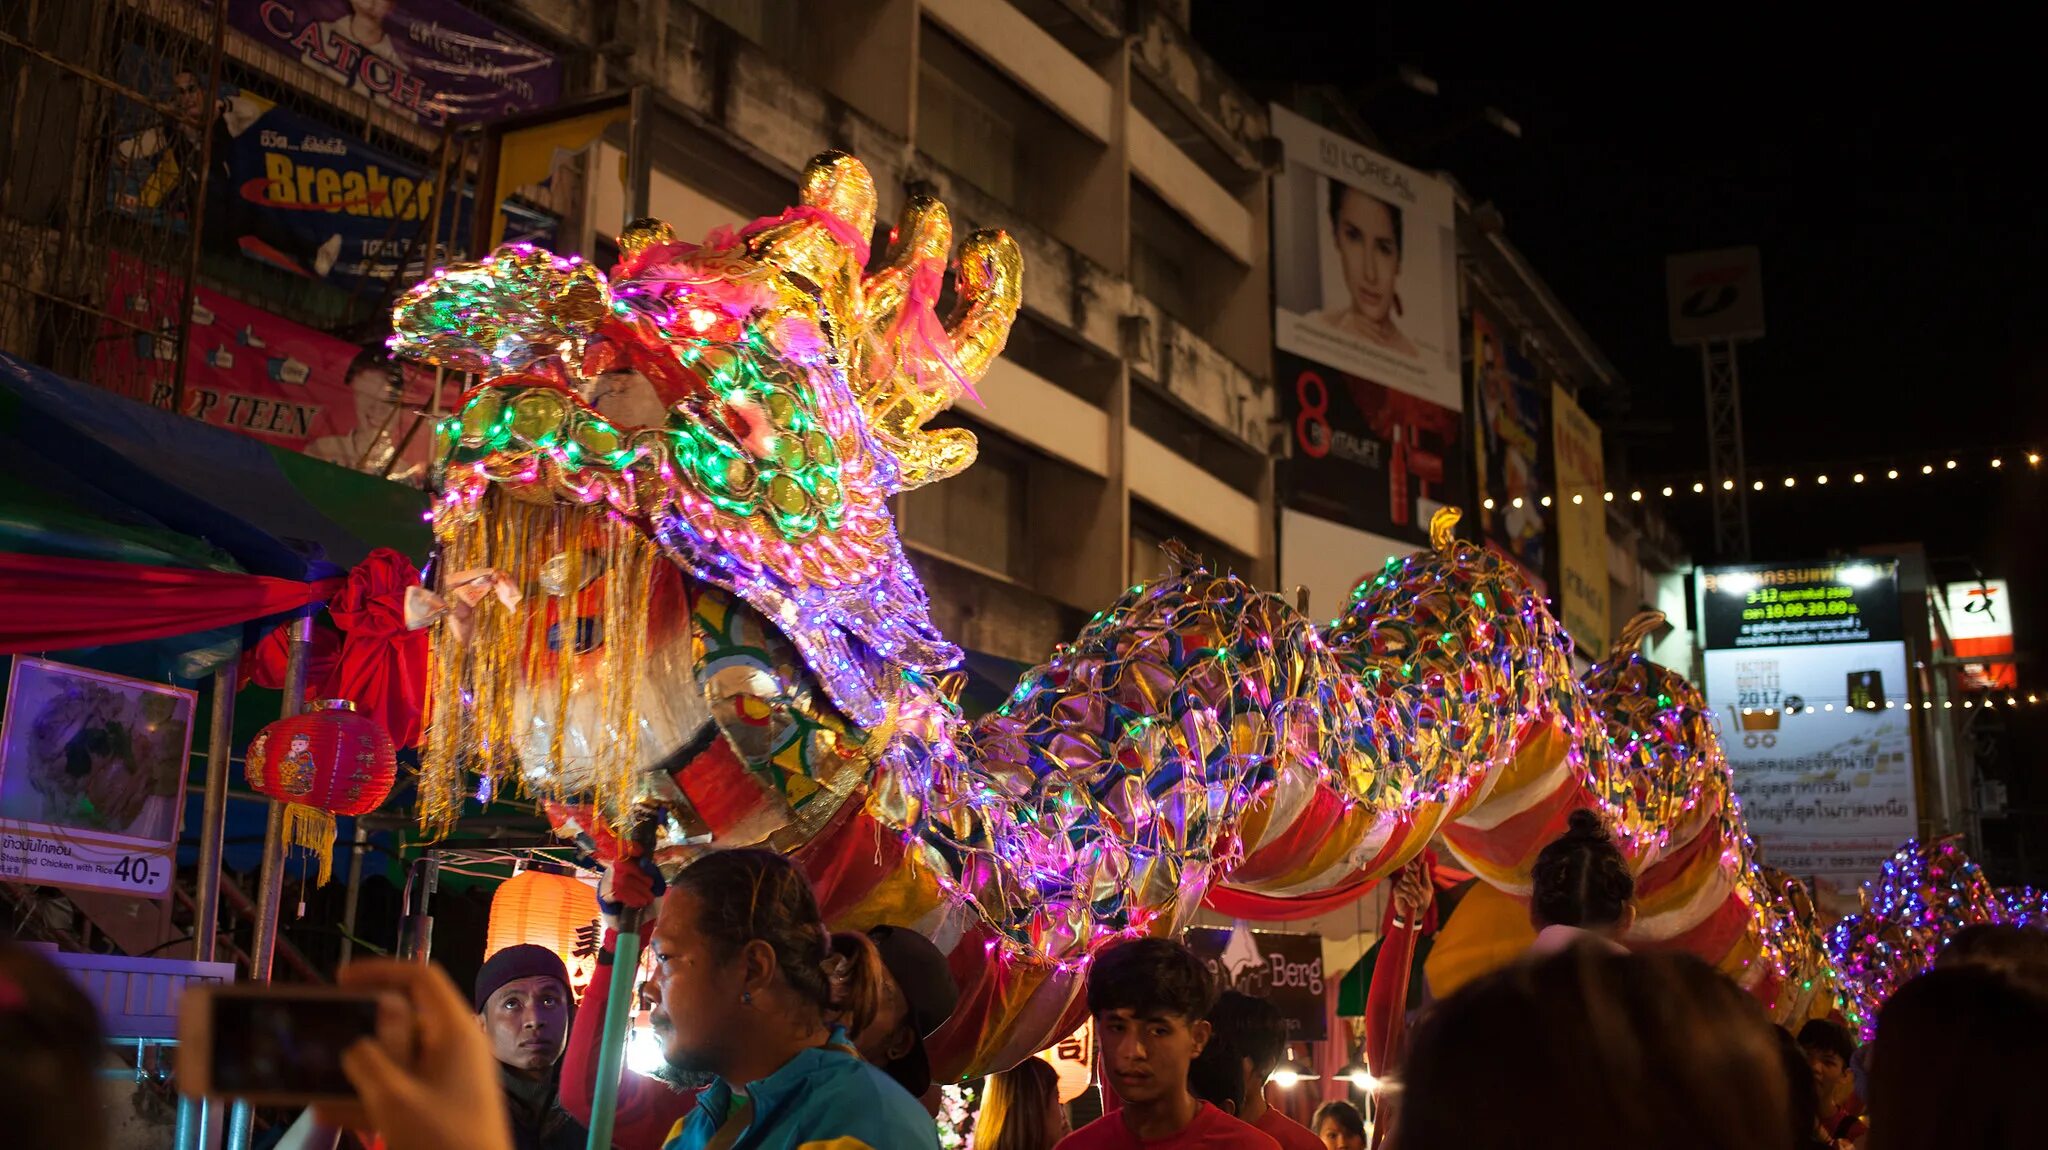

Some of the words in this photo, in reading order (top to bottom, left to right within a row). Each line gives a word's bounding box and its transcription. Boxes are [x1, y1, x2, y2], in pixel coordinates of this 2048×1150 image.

[264, 151, 433, 221] Breaker
[225, 394, 318, 435] TEEN
[1296, 369, 1332, 459] 8
[1765, 601, 1847, 618] 10.00-20.00
[1738, 690, 1781, 706] 2017
[3, 836, 72, 856] ข้าวมันไก่ตอน
[0, 854, 38, 865] Steamed
[40, 858, 73, 870] Chicken
[76, 863, 93, 872] with
[95, 865, 113, 875] Rice
[1269, 953, 1323, 995] Berg
